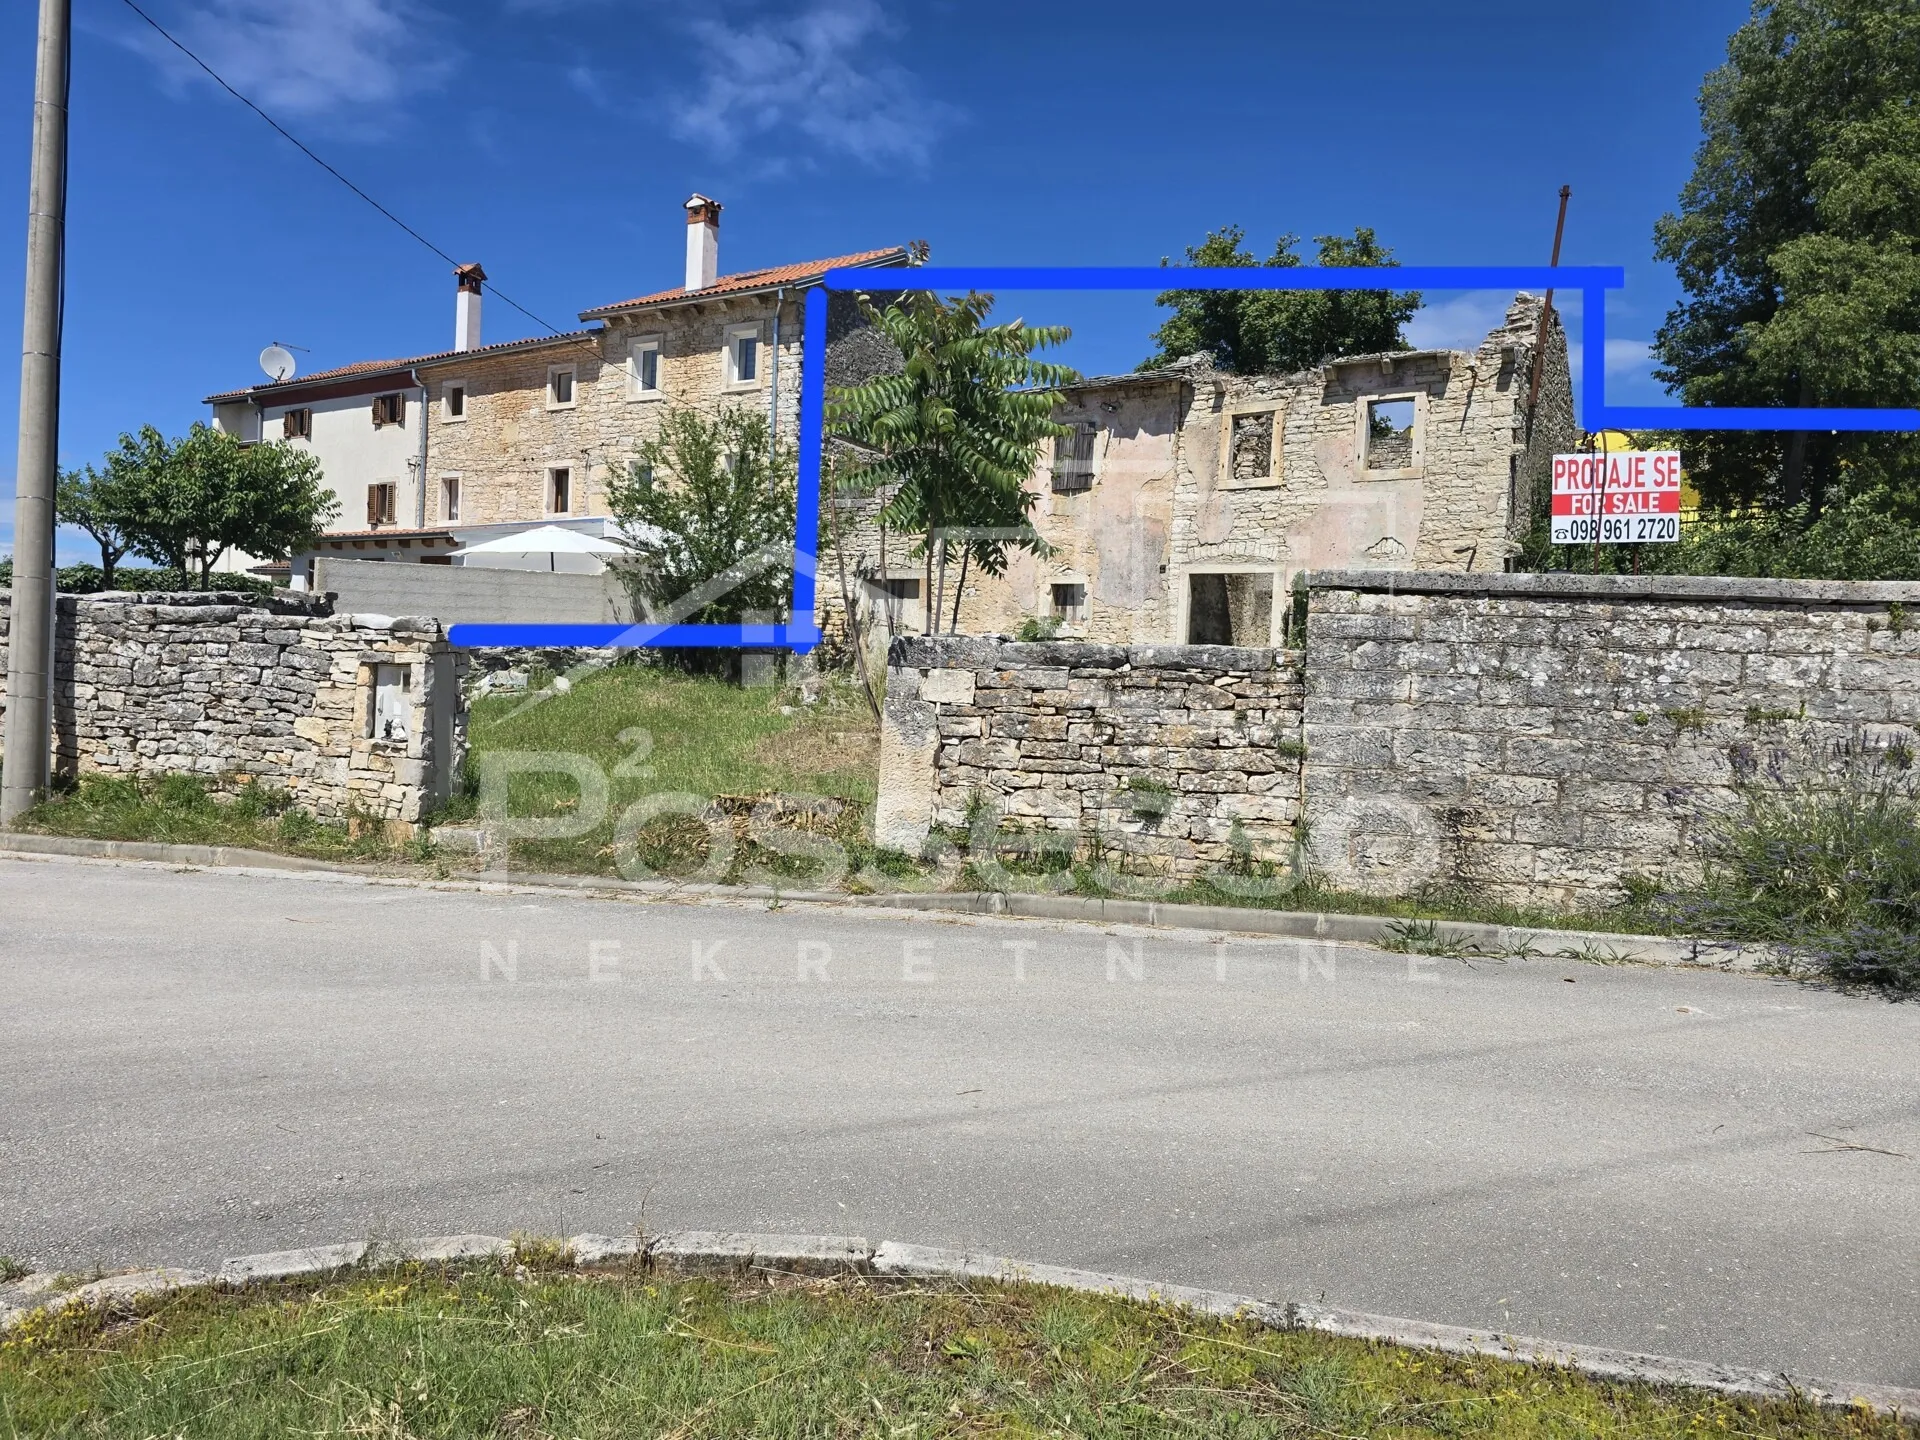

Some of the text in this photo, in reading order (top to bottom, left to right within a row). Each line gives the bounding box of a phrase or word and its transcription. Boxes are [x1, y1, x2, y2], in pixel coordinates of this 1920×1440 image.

[1554, 456, 1678, 490] PRODAJE SE
[1571, 493, 1660, 515] FOR SALE
[1570, 518, 1675, 540] 098 961 2720
